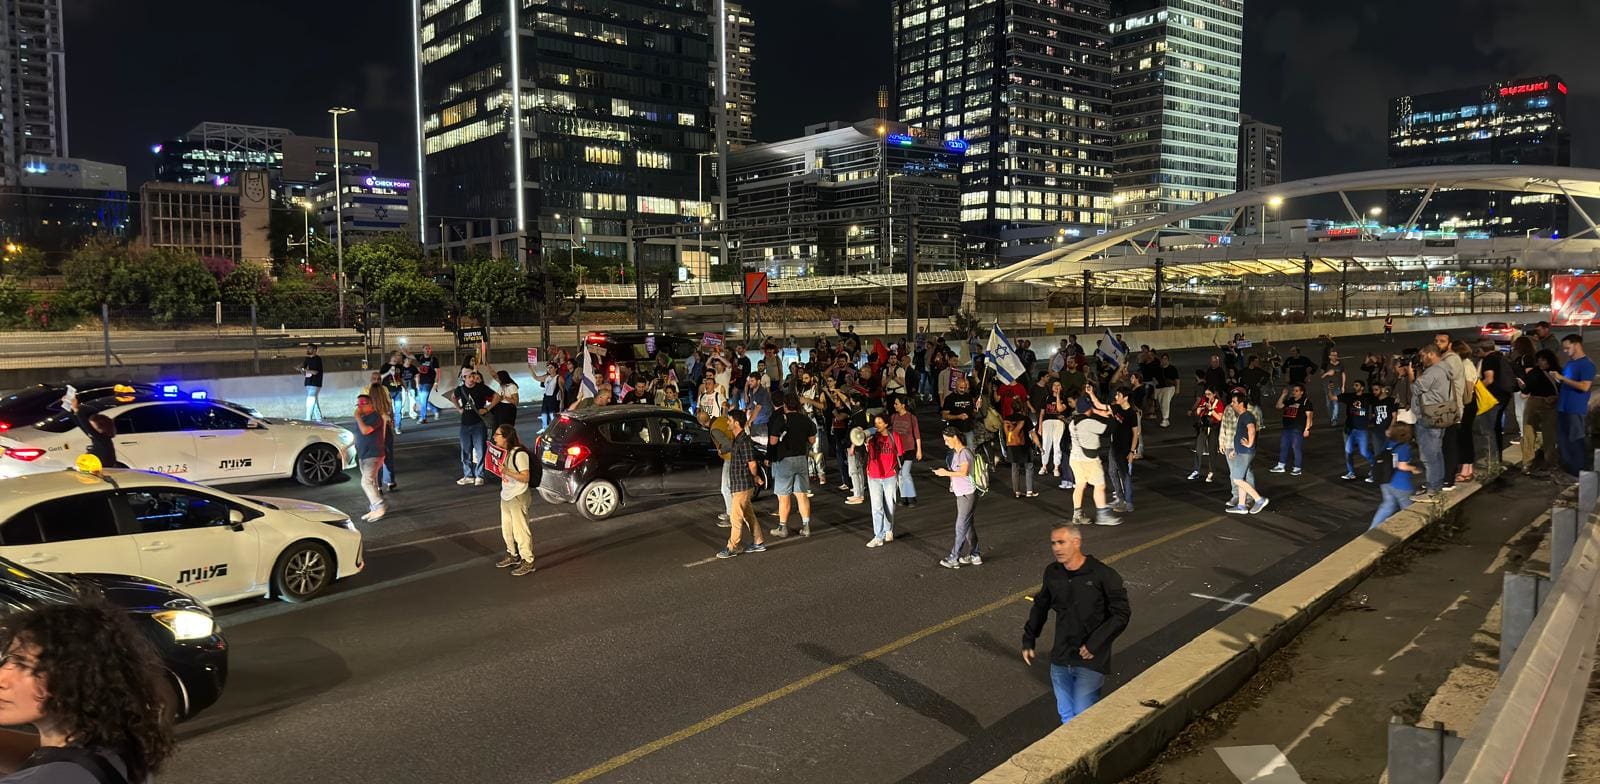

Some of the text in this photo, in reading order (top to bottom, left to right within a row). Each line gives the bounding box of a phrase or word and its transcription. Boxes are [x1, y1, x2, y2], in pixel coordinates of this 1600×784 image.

[1499, 81, 1549, 96] SUZUKI
[219, 458, 252, 469] מונית
[176, 563, 228, 584] מונית
